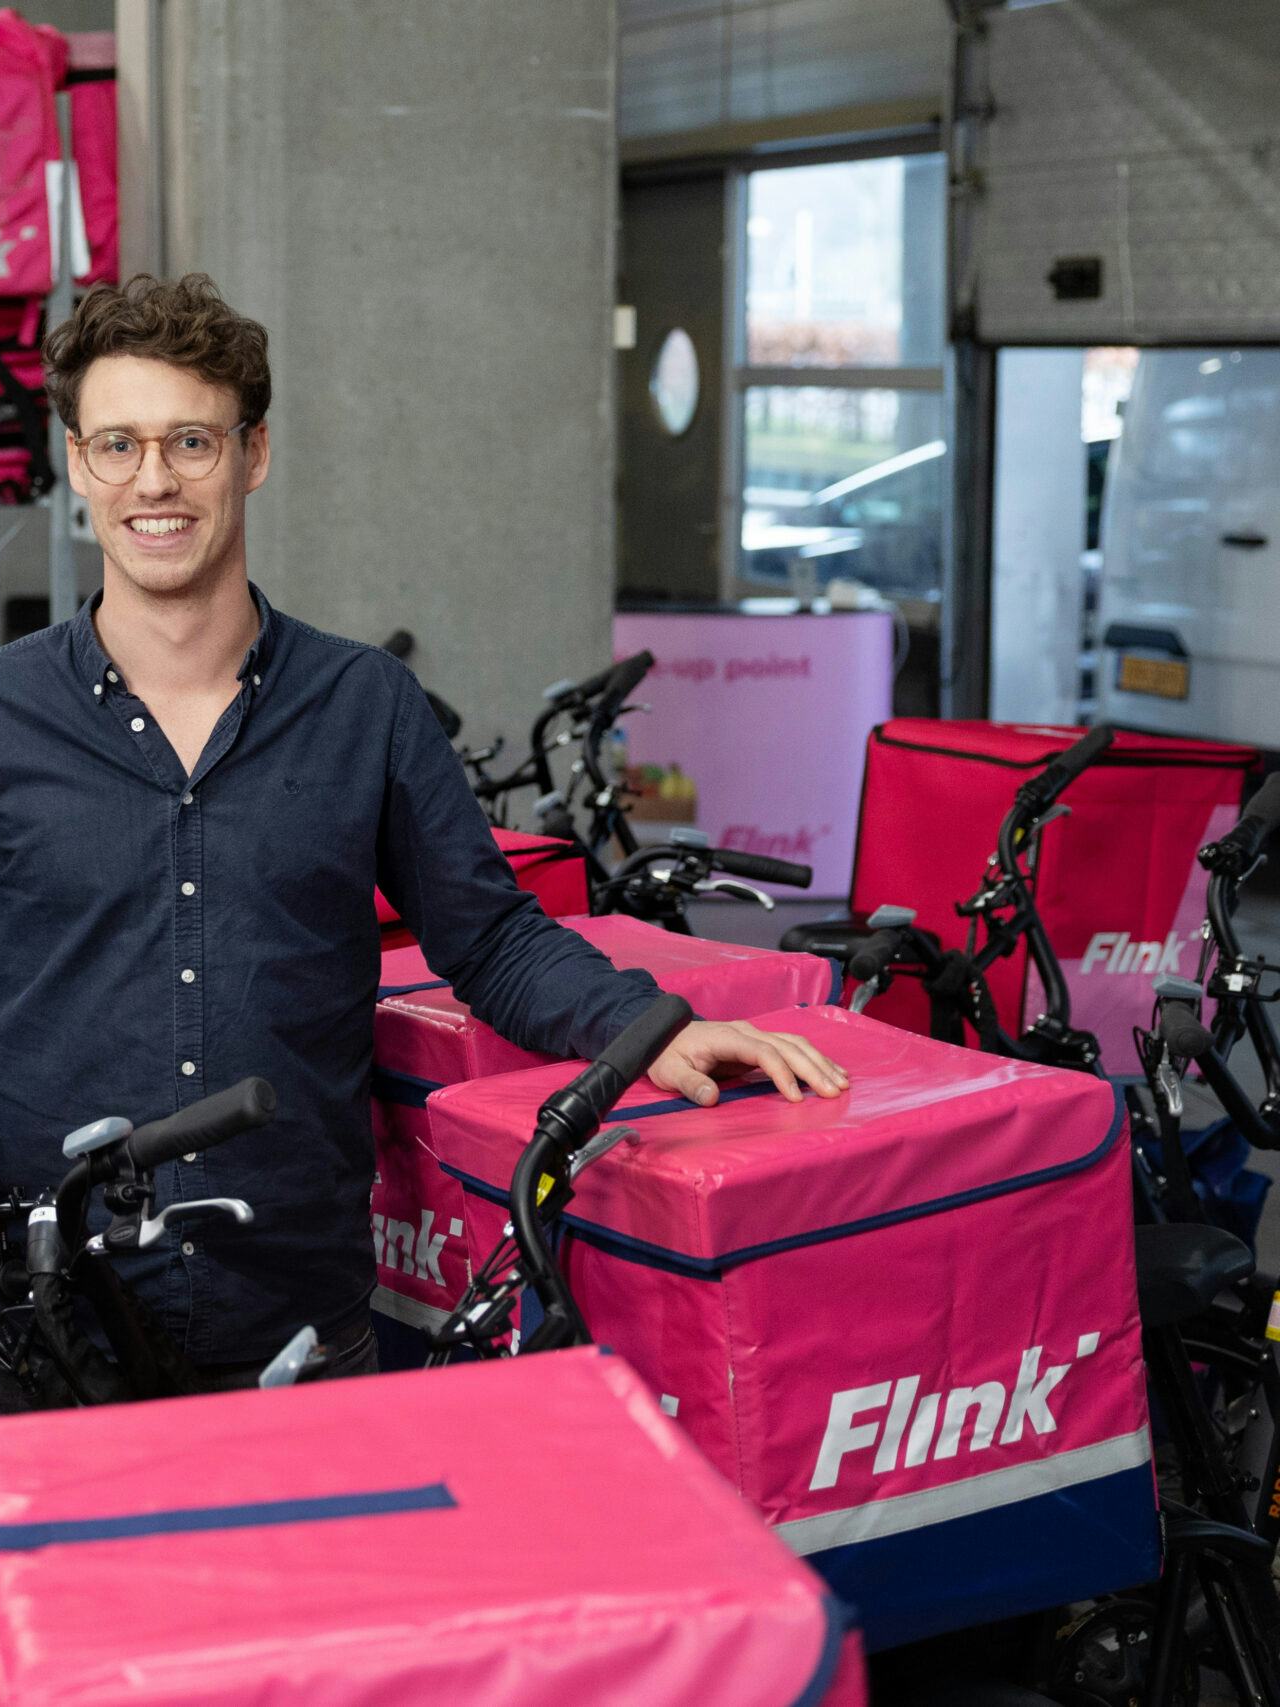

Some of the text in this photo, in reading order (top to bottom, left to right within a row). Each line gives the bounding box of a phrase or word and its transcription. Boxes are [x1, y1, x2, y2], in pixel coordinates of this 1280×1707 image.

[1080, 931, 1199, 975] Flink
[371, 1209, 463, 1287] ink
[808, 1331, 1102, 1492] Flink
